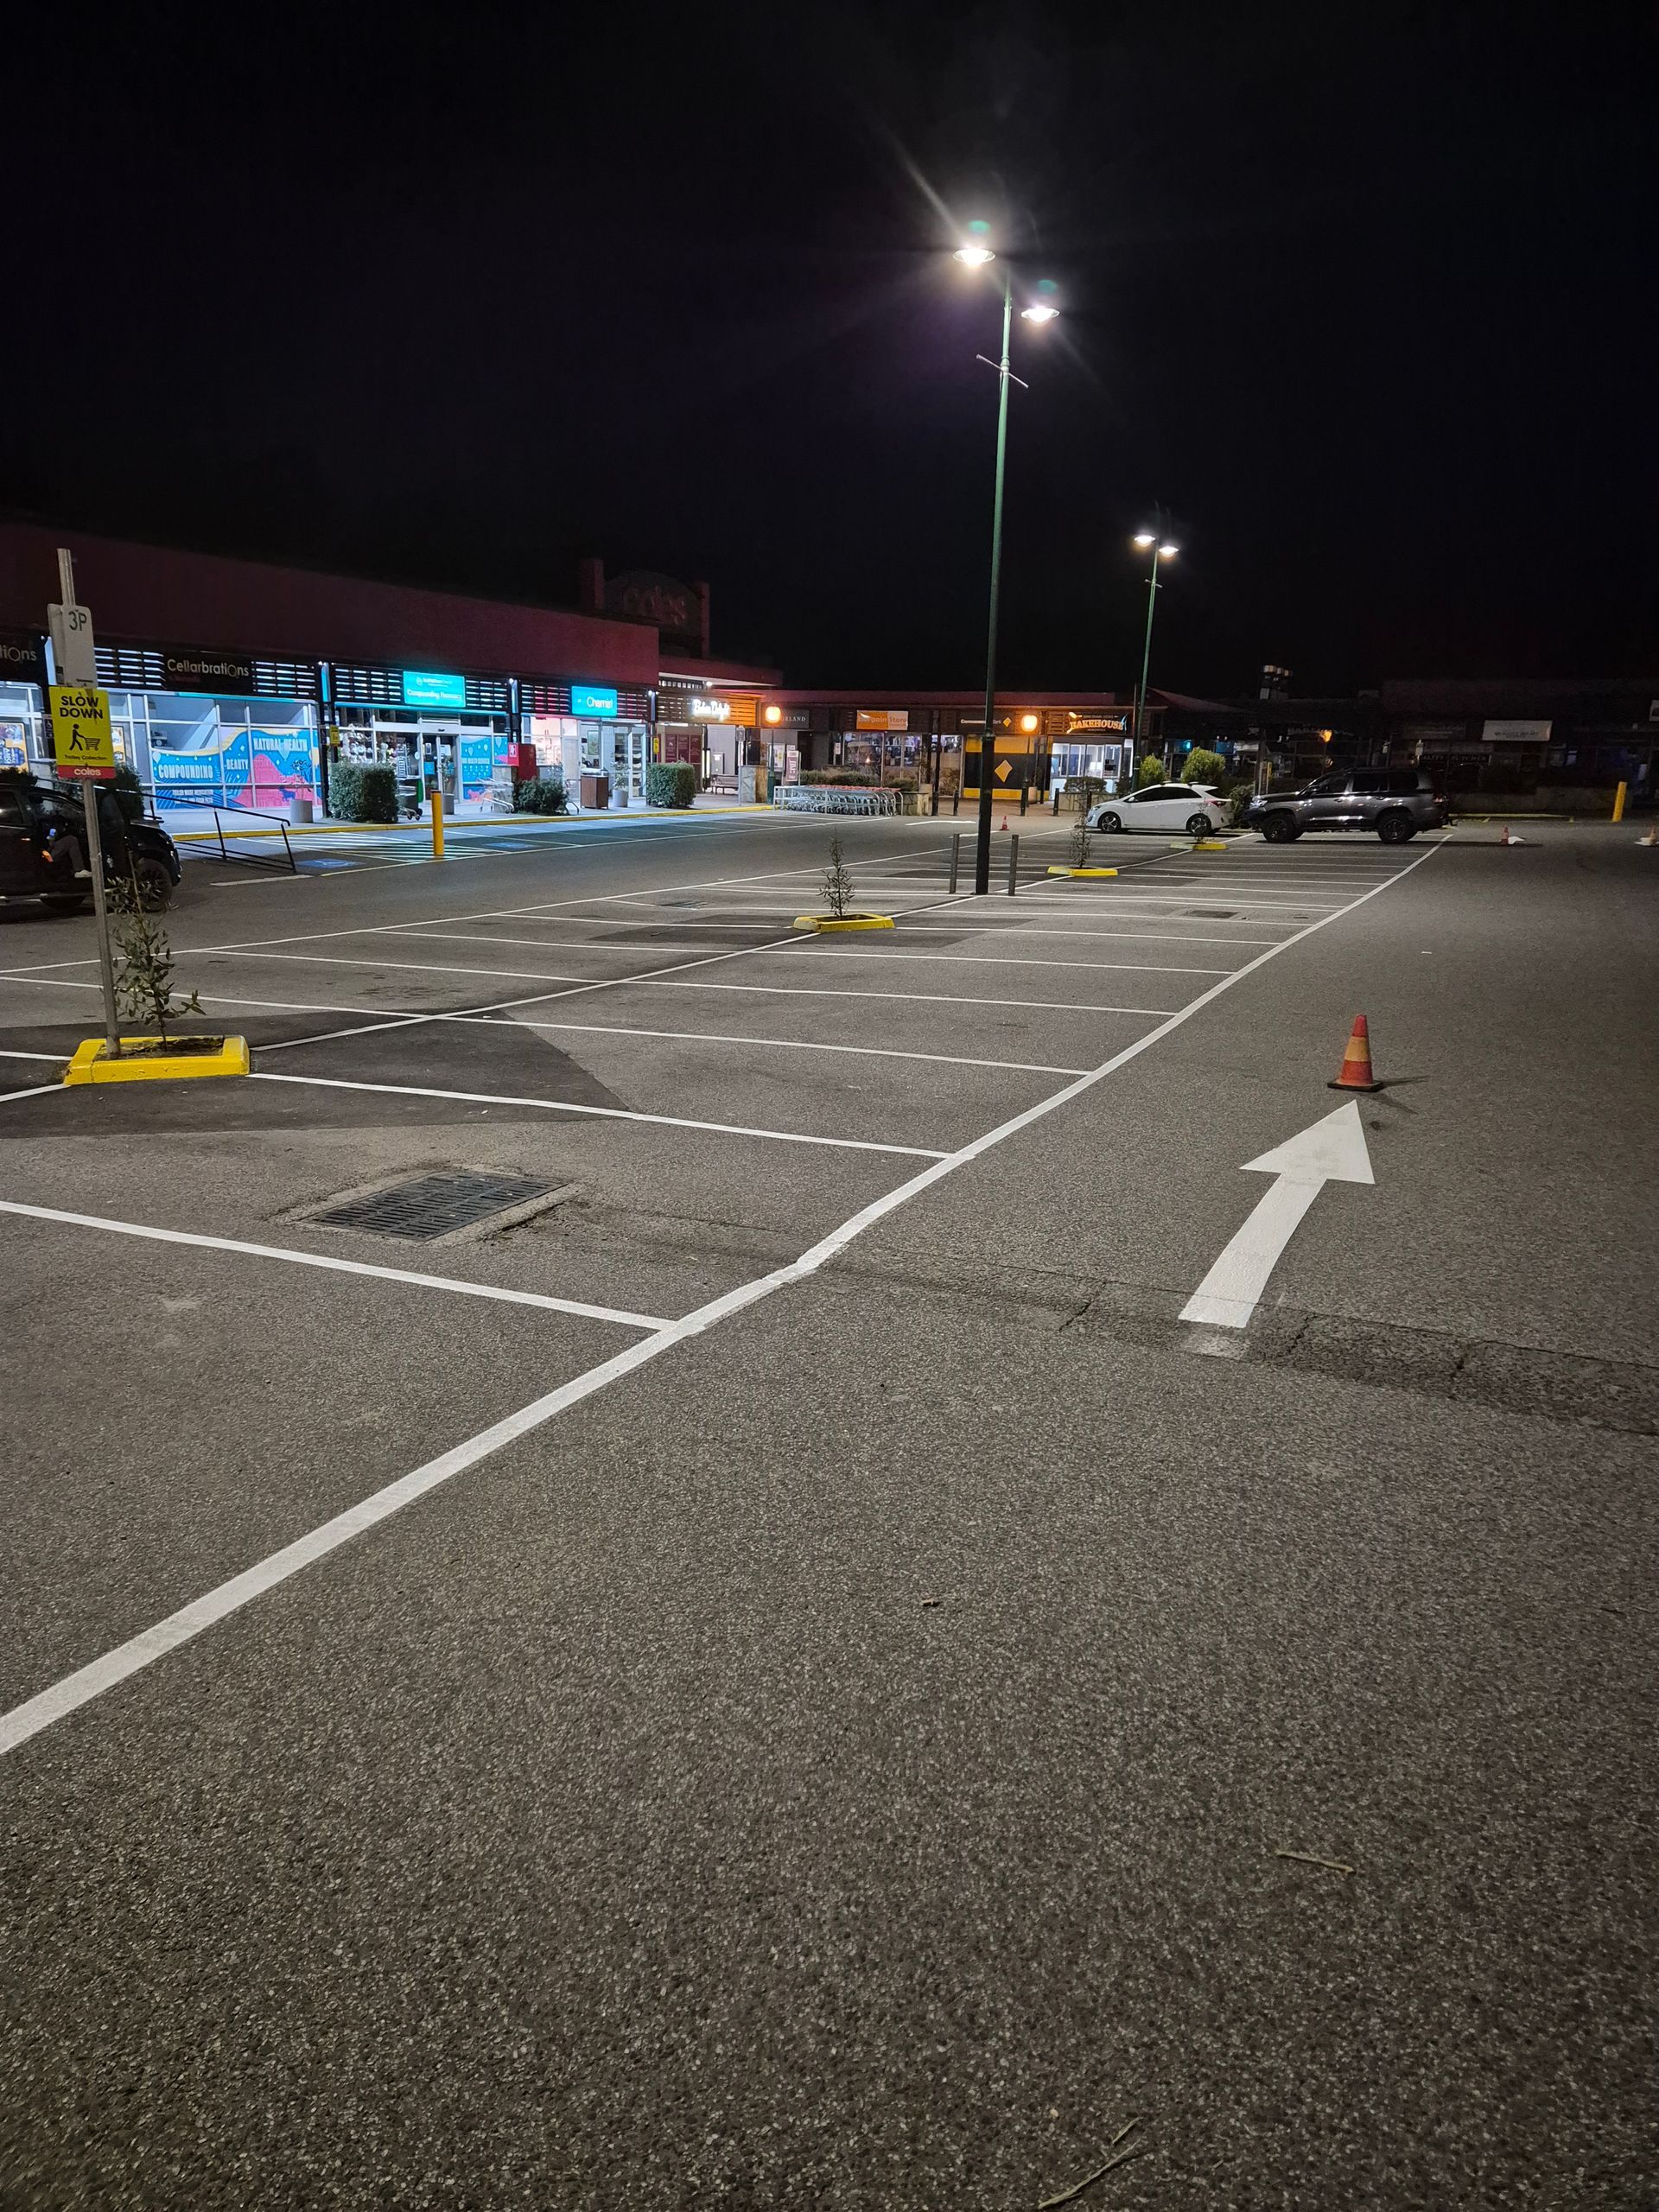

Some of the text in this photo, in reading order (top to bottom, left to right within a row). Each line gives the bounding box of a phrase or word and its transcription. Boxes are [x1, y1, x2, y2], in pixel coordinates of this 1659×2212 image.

[68, 611, 87, 631] 3P
[167, 658, 250, 677] Cellarbrations
[60, 696, 99, 707] SLOW
[59, 708, 104, 719] DOWN
[226, 759, 249, 770] BEAUTY
[73, 767, 102, 776] coles
[158, 764, 213, 779] COMPOUNDING
